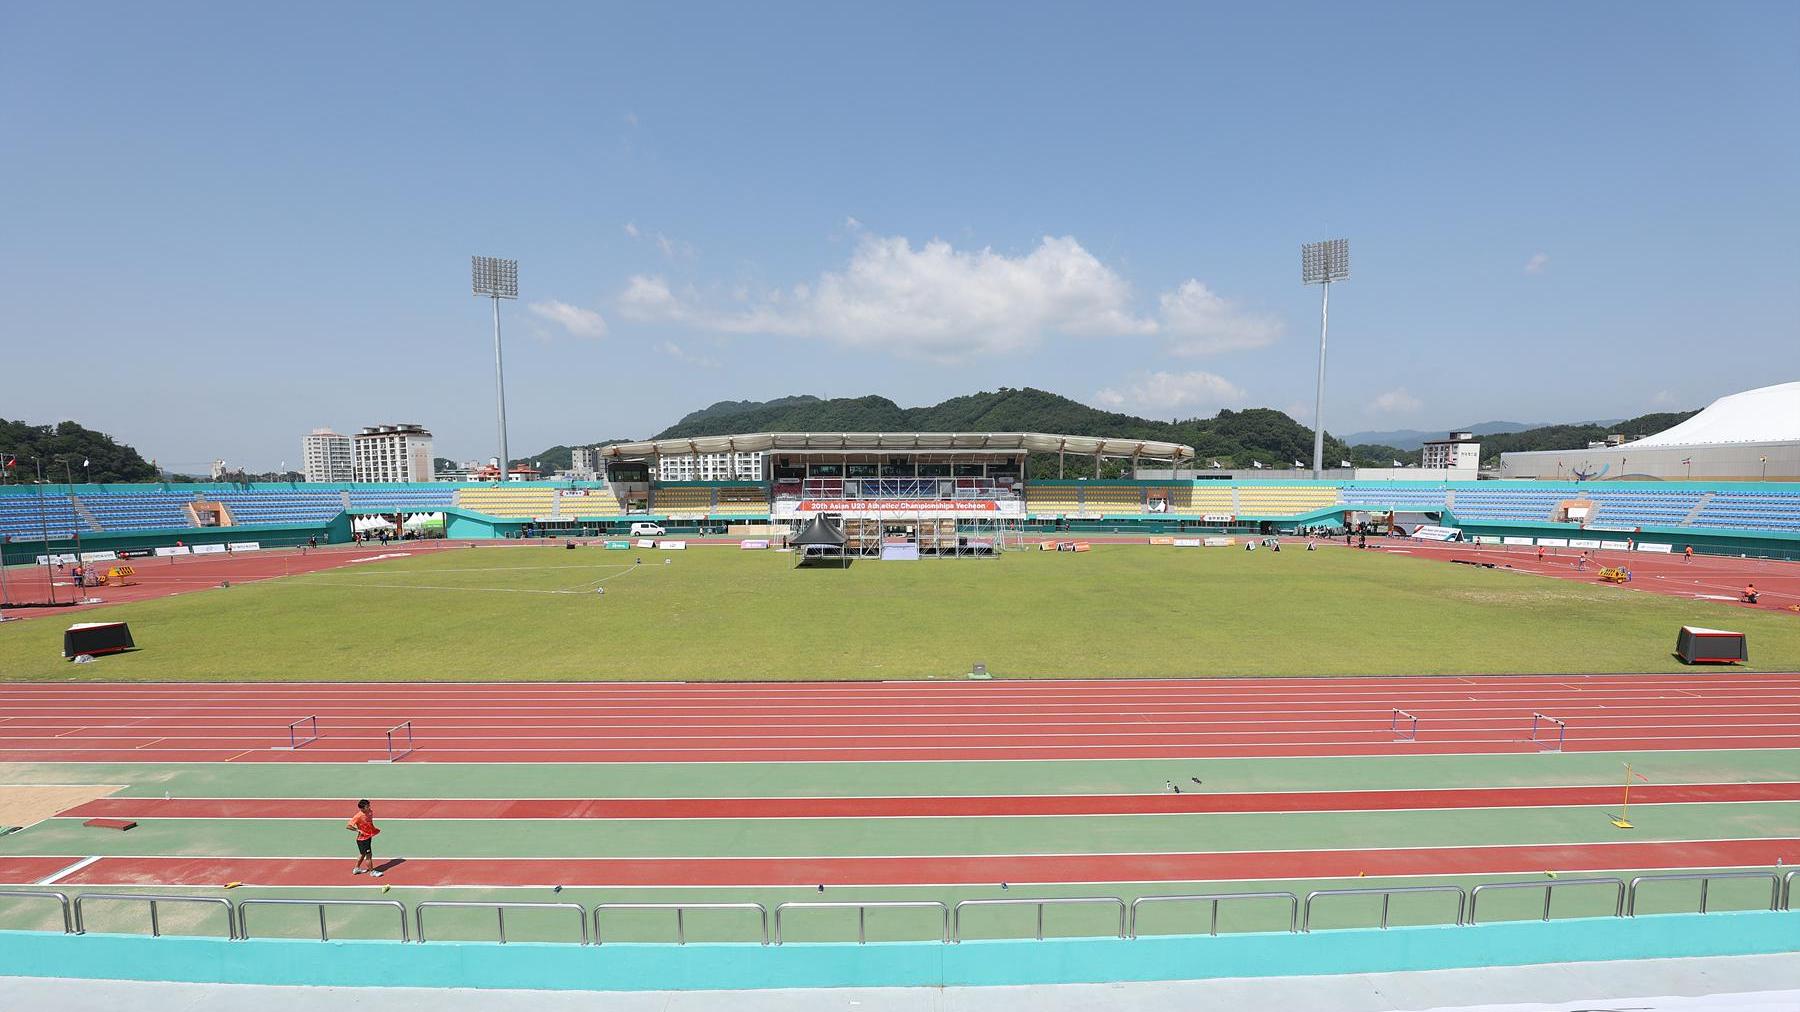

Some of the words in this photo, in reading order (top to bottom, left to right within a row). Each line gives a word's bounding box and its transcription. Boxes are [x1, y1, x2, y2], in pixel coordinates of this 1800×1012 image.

[811, 502, 828, 510] 20th
[830, 502, 850, 510] Asian
[851, 502, 866, 510] U20
[867, 502, 900, 510] Athetics
